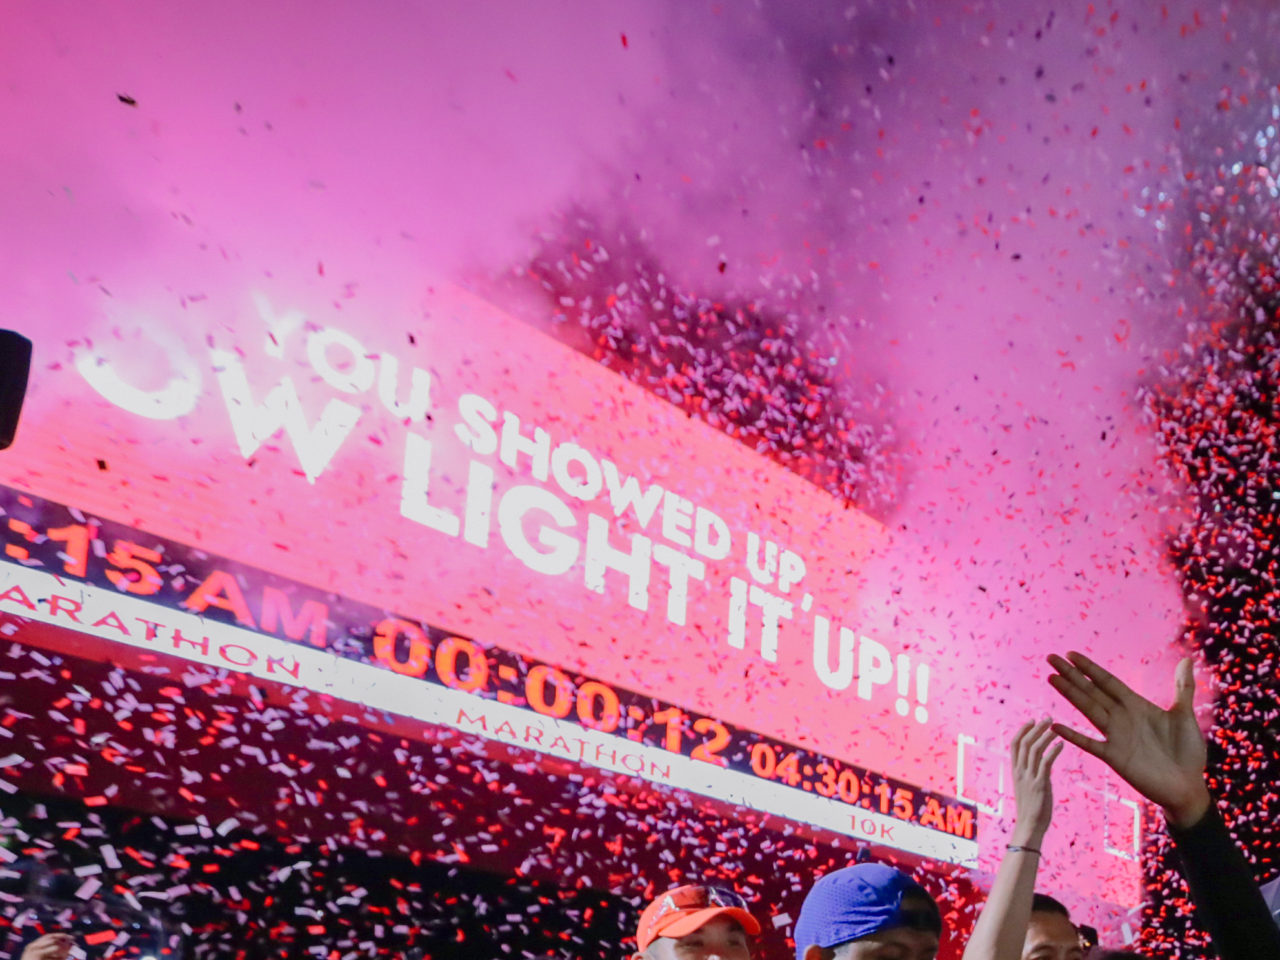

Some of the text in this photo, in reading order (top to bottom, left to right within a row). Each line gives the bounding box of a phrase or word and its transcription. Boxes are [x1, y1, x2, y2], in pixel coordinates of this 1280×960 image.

[252, 293, 431, 423] YOU
[454, 393, 732, 560] SHOWED
[74, 300, 931, 724] OW LIGHT IT UP!!
[0, 584, 301, 680] ARATHON
[184, 570, 330, 649] AM
[373, 618, 731, 769] 00:00:12
[456, 707, 671, 780] MARATHON
[750, 742, 914, 820] 04:30:15
[847, 814, 896, 841] 10K
[920, 796, 974, 839] AM
